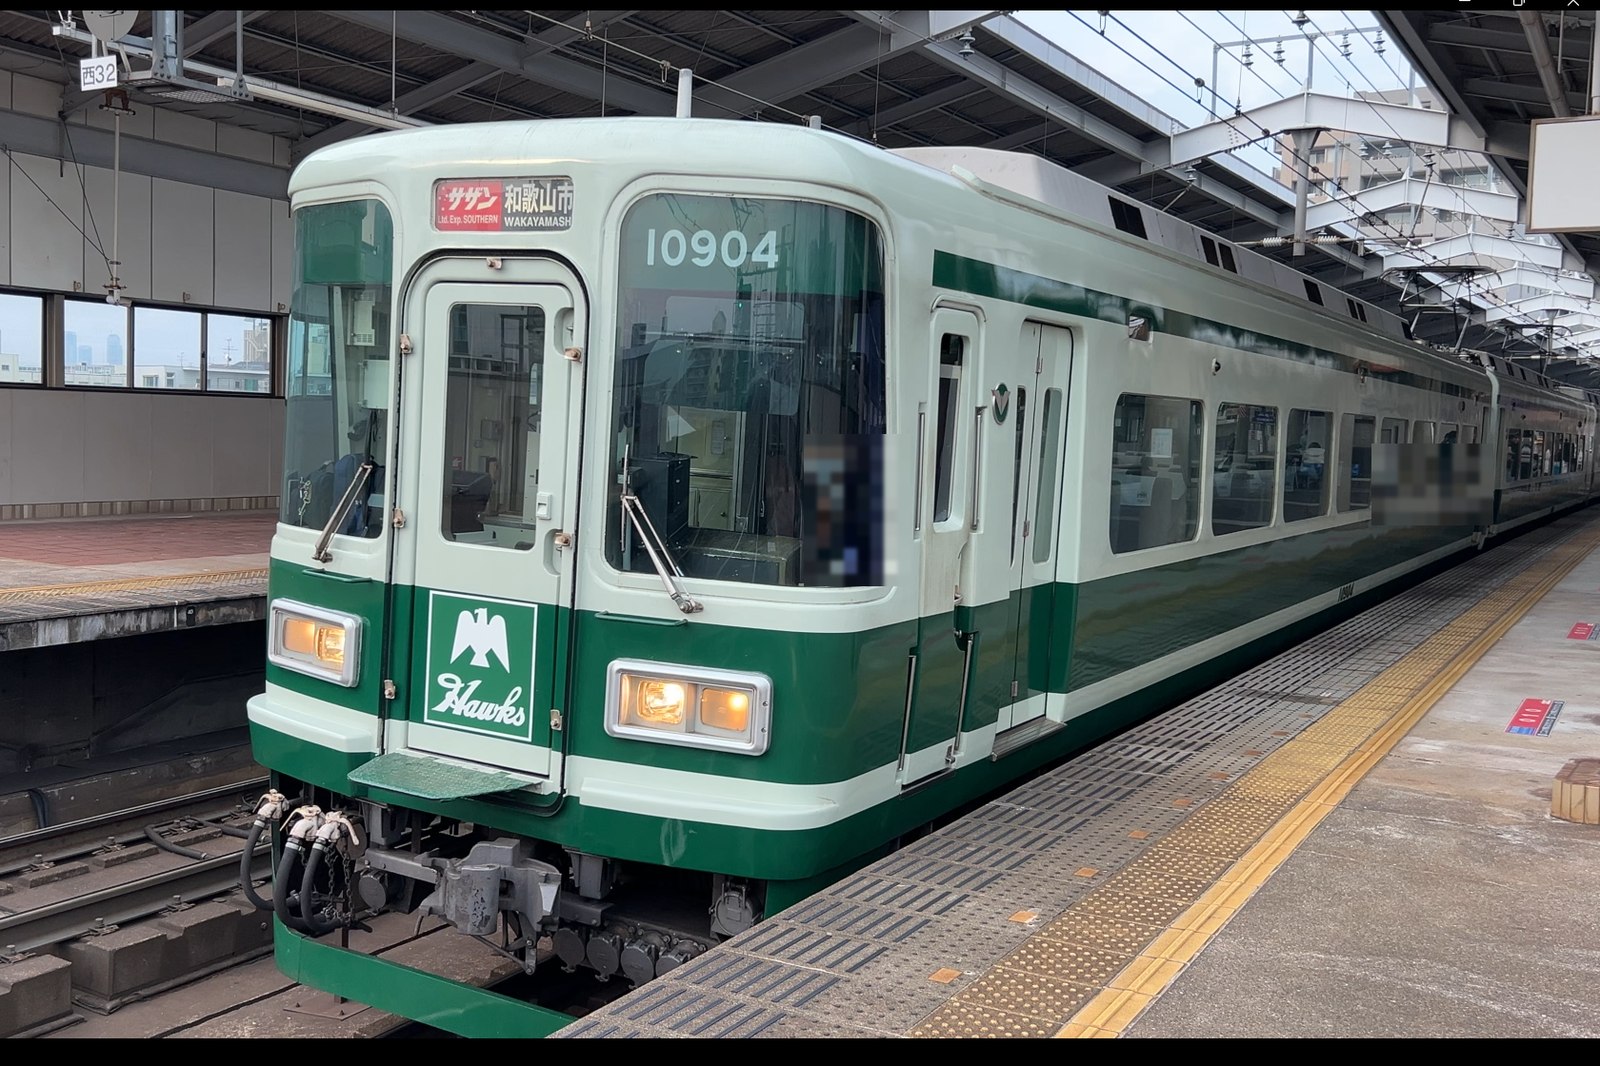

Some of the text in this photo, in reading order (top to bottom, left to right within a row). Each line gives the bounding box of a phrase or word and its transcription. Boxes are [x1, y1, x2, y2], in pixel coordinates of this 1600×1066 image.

[82, 63, 115, 86] 西32
[448, 186, 498, 211] サザン
[504, 182, 574, 214] 和歌山市
[438, 215, 498, 225] Ltd. Exp. SOUTHERN
[647, 229, 779, 268] 10904
[431, 672, 526, 727] Hawks
